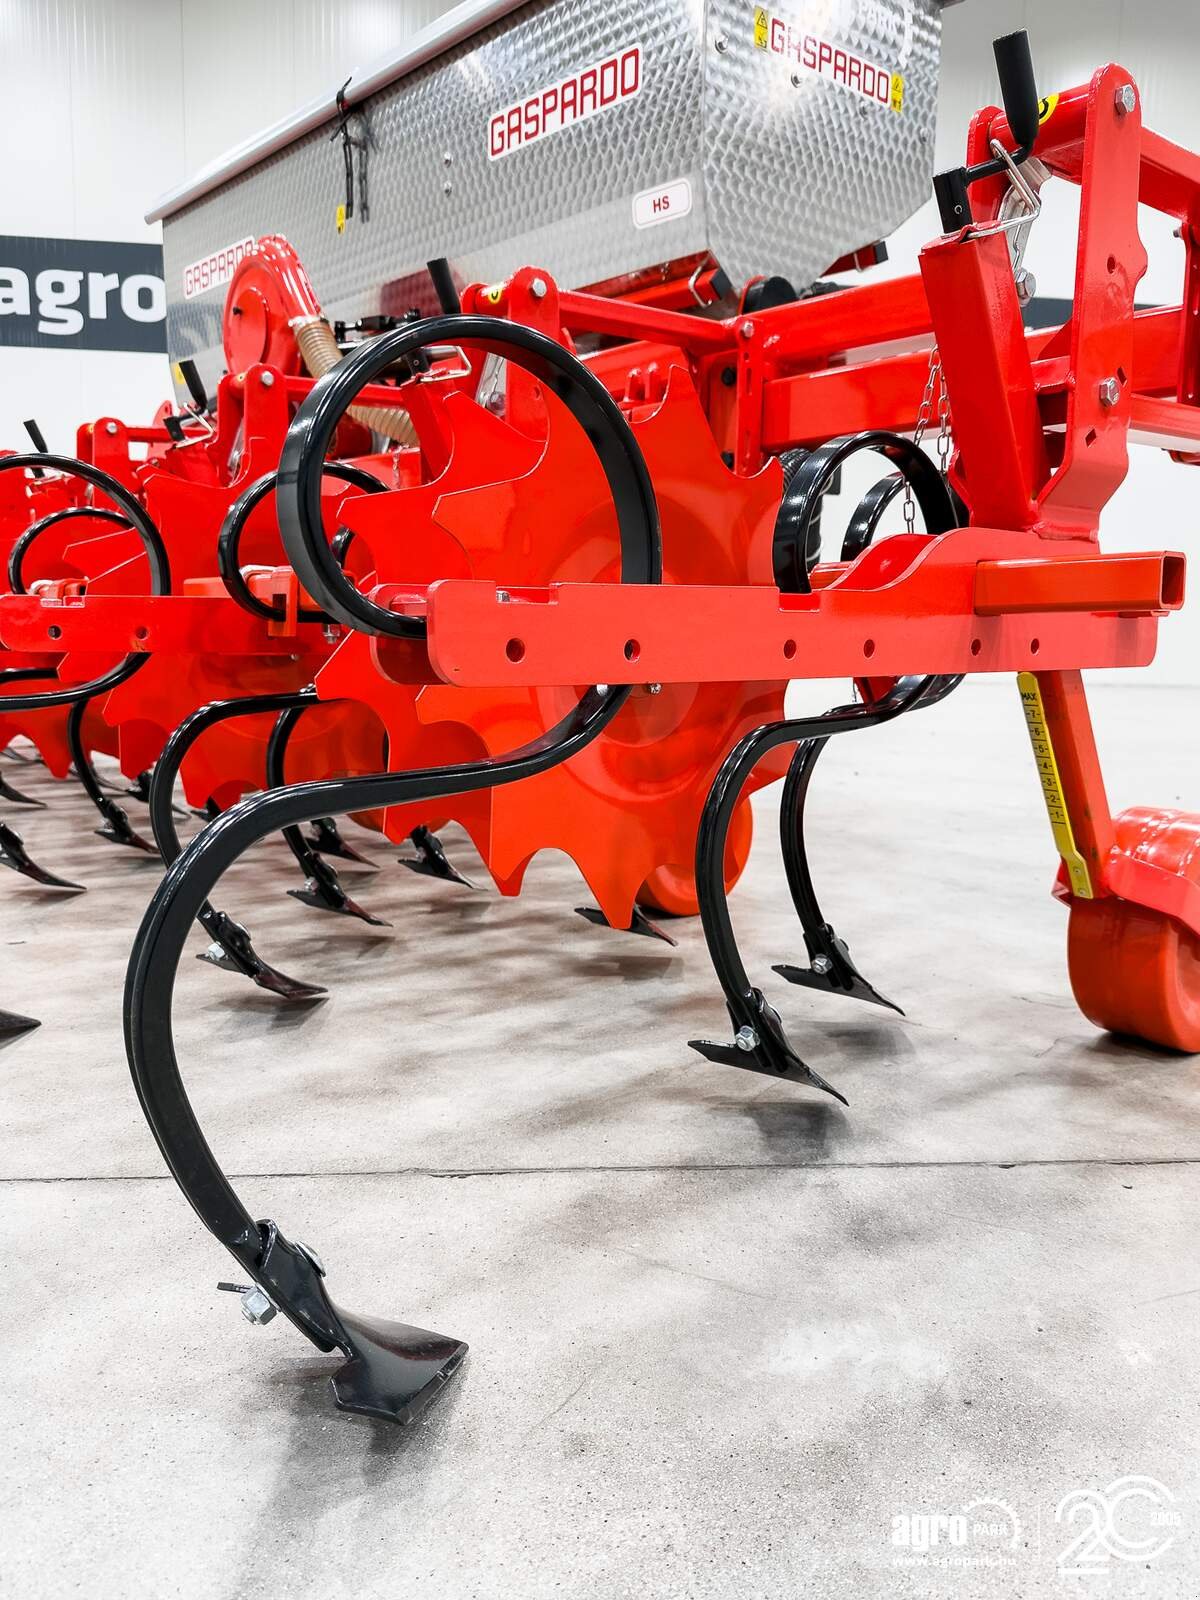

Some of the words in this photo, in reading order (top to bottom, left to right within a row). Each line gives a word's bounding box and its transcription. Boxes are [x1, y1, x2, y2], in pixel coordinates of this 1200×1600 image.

[490, 49, 640, 157] GASPARDO
[653, 195, 670, 214] HS
[0, 266, 167, 336] agro
[1021, 692, 1038, 701] MAX
